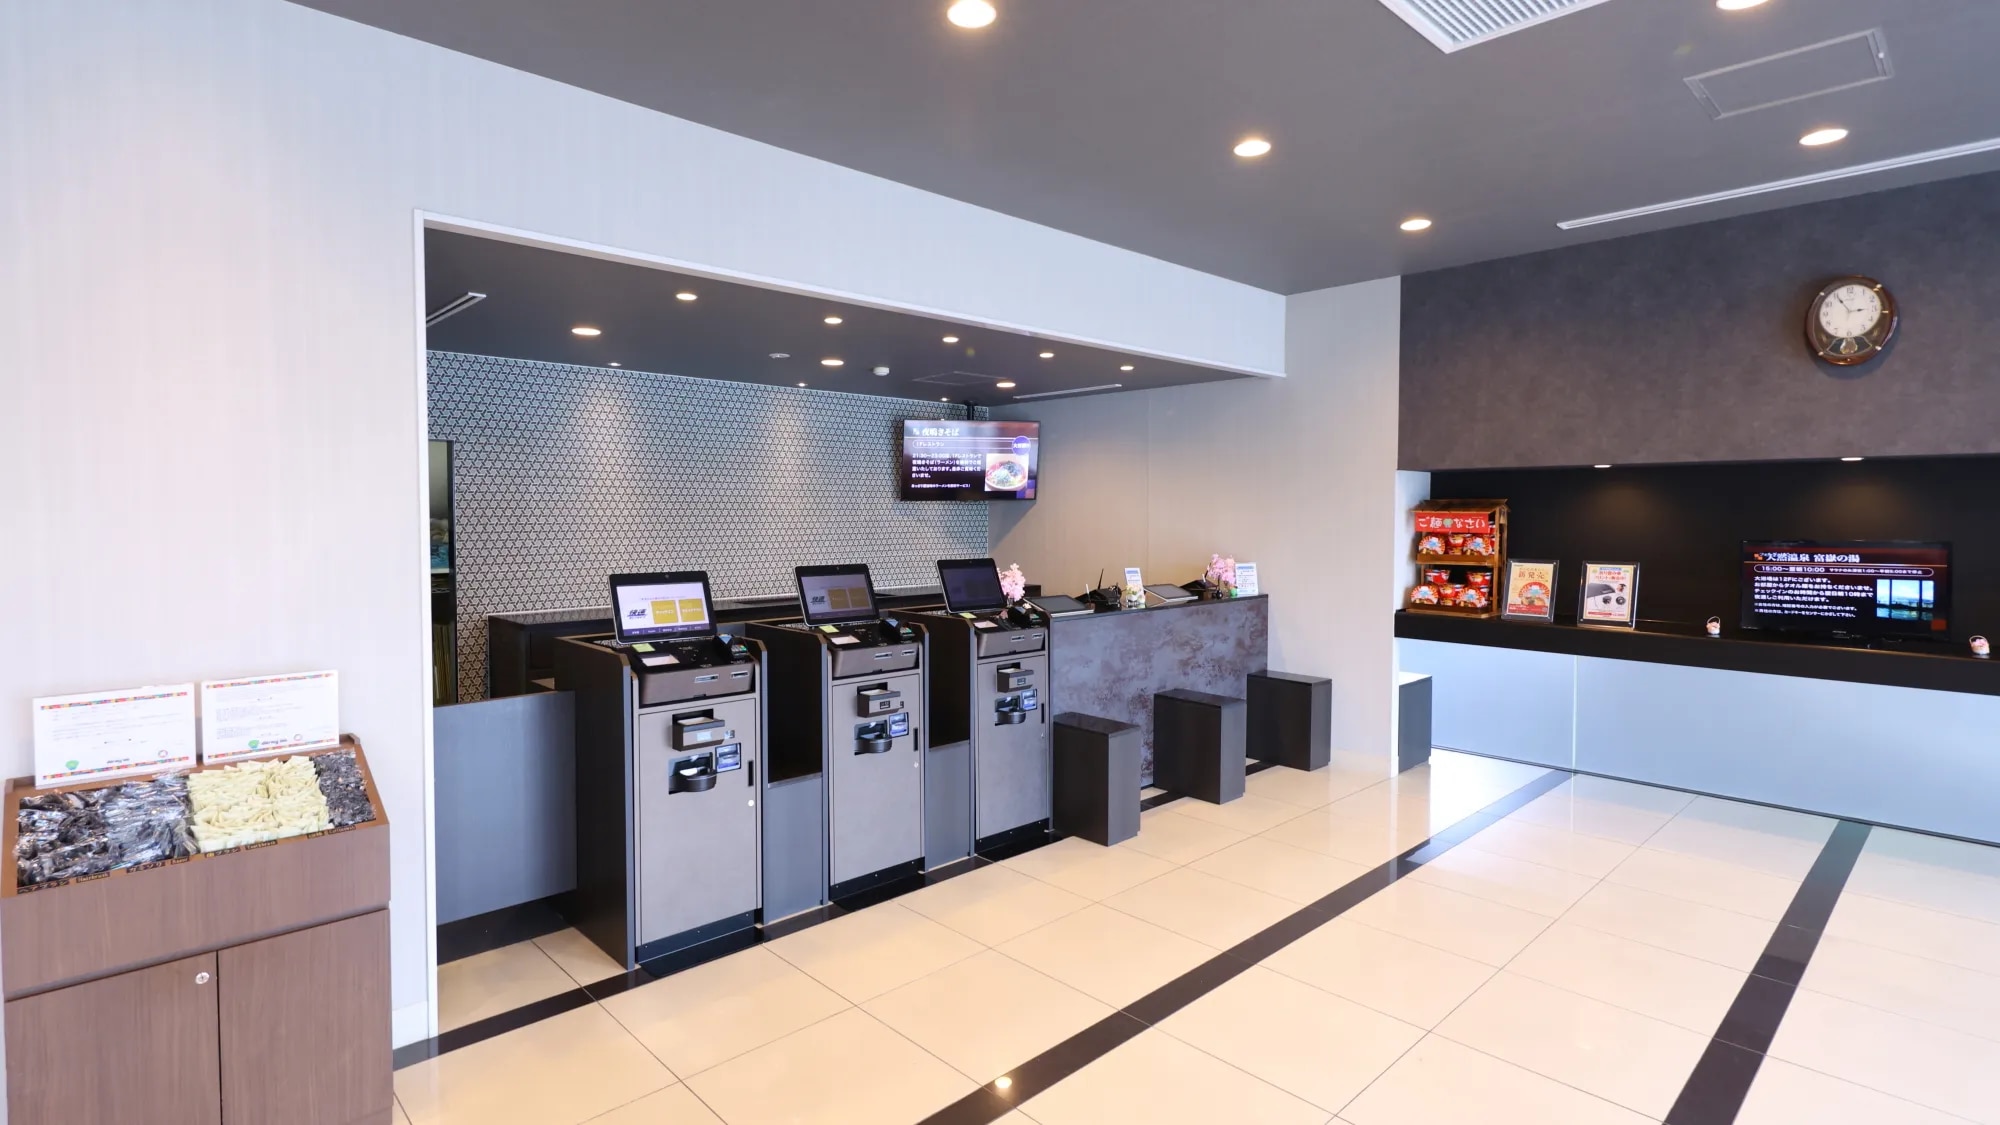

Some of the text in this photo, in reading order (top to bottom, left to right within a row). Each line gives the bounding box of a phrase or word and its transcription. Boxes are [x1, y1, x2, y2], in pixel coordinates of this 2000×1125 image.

[1765, 552, 1860, 564] 天然温泉 富嶽の湯
